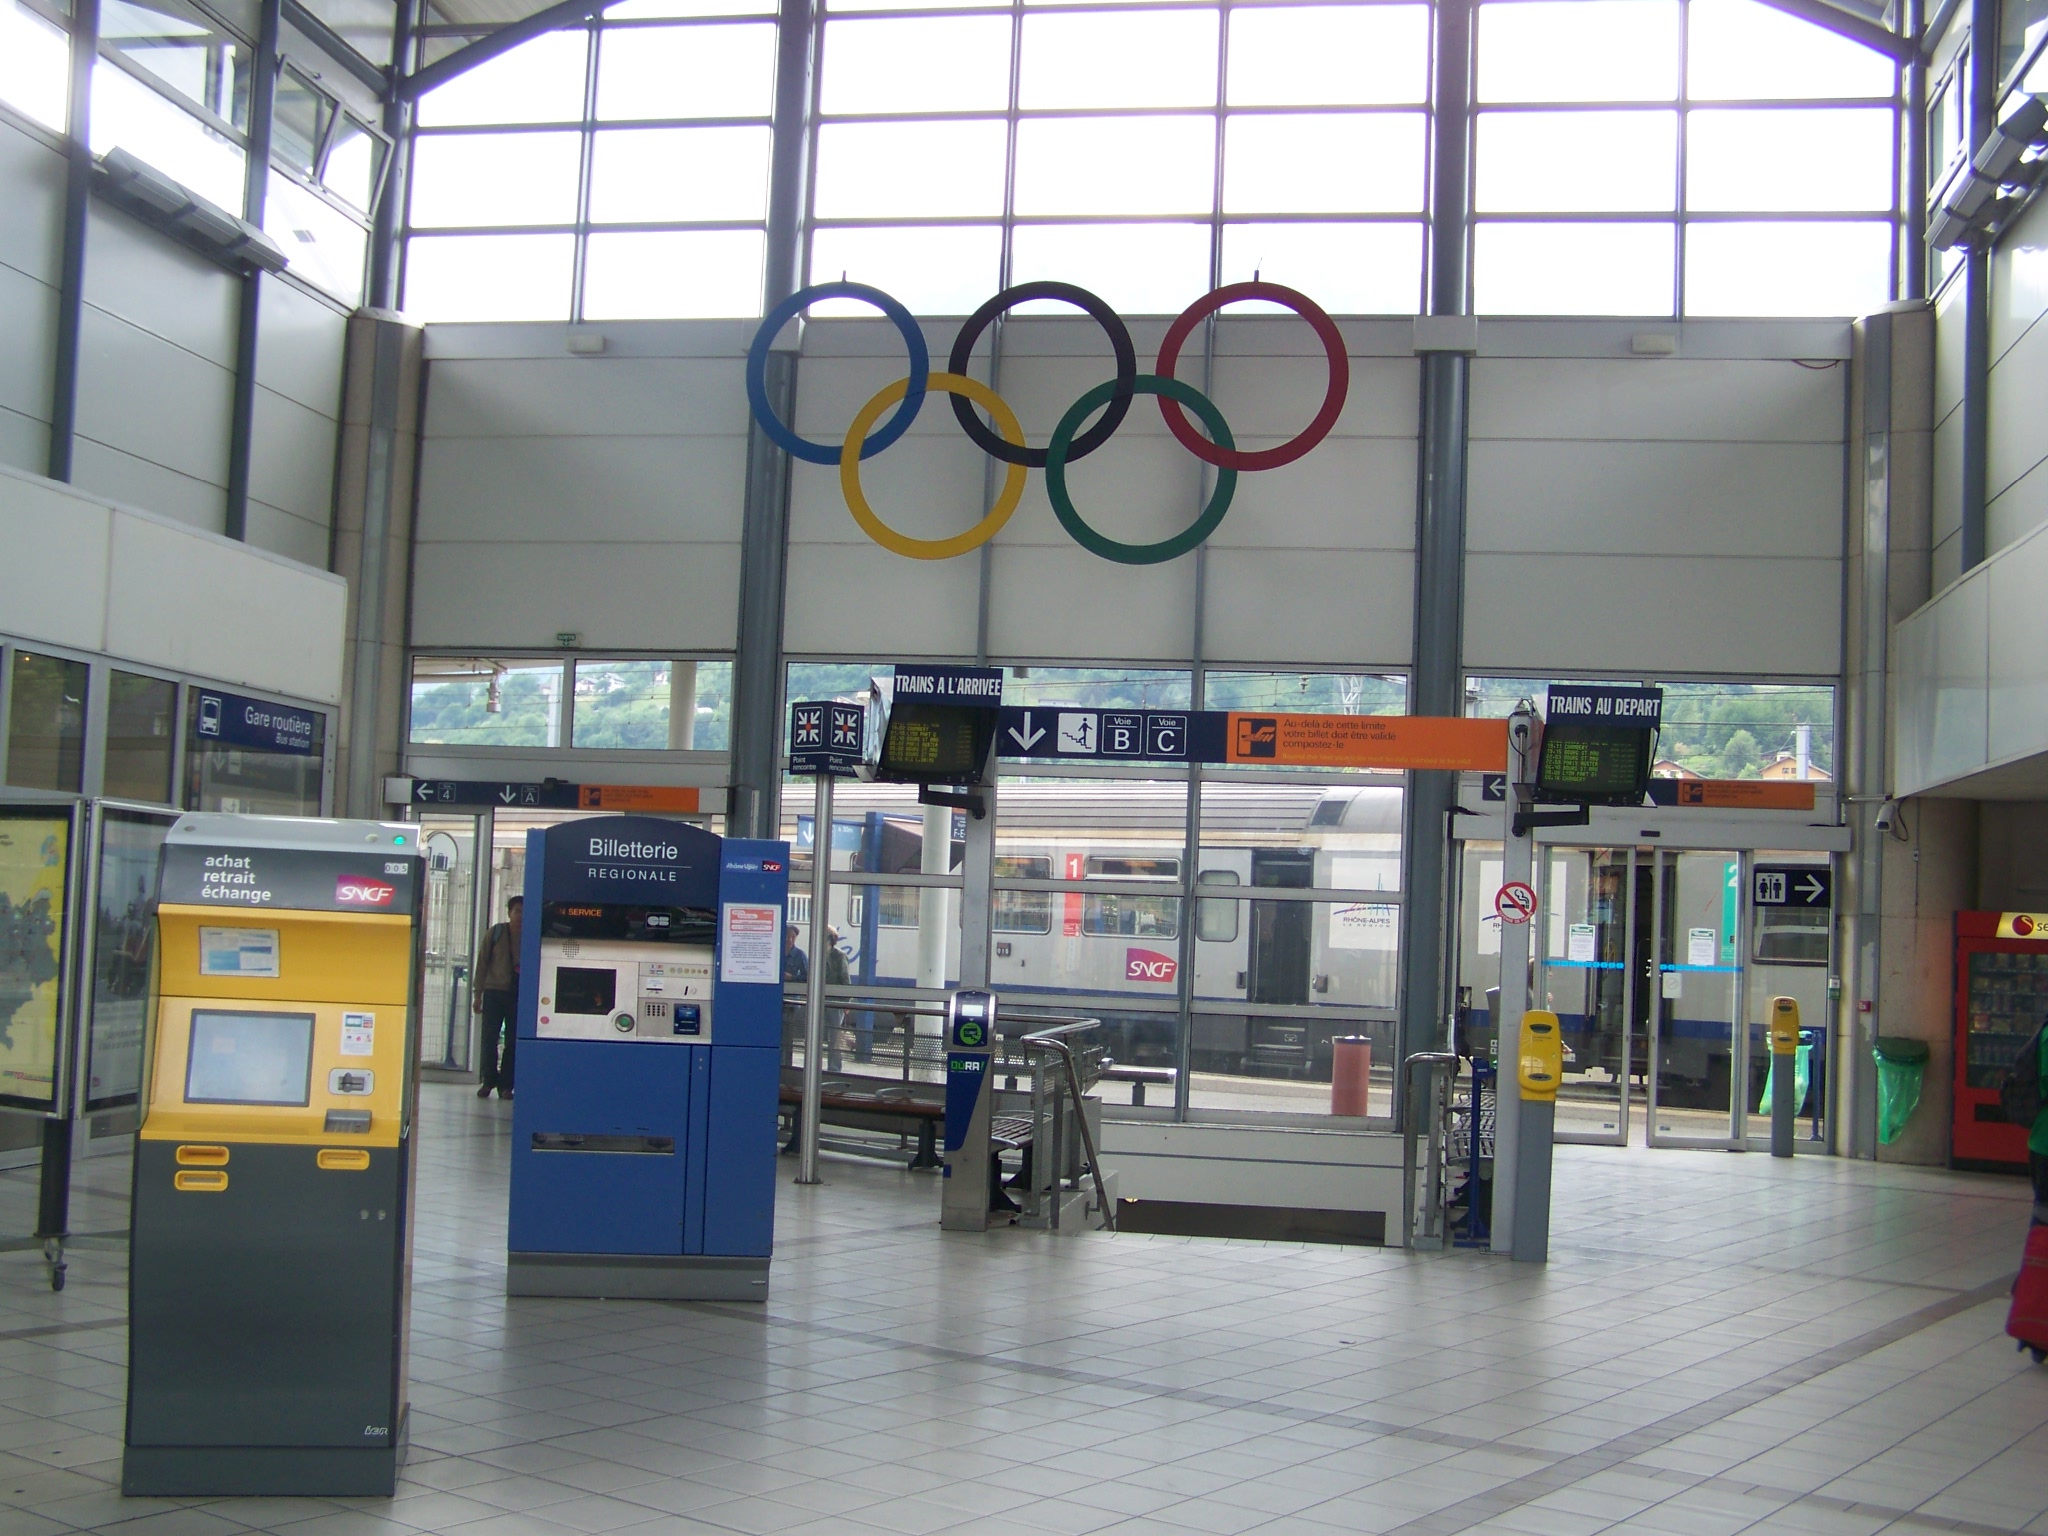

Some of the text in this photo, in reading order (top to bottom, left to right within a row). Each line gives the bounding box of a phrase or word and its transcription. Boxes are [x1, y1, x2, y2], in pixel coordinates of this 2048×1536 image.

[895, 675, 1002, 696] TRAINS A L'ARRIVEE
[1550, 696, 1660, 717] TRAINS AU DEPART
[245, 706, 311, 735] Gare routière
[1113, 717, 1132, 725] Voie
[1158, 718, 1176, 727] Voie
[1284, 719, 1386, 730] Au-delà de cette limite
[275, 732, 310, 749] Bus station
[1114, 729, 1130, 750] B
[1157, 730, 1175, 752] C
[1283, 729, 1397, 741] votre billet doit être validé
[1282, 740, 1345, 749] compostez-le
[829, 756, 843, 764] Point
[525, 792, 535, 803] A
[589, 838, 678, 860] Billetterie
[205, 854, 251, 869] achat
[385, 863, 408, 874] 005
[1070, 858, 1078, 878] 1
[203, 870, 256, 884] retrait
[588, 868, 677, 882] REGIONALE
[201, 885, 272, 903] échange
[338, 886, 393, 902] SNCF
[568, 908, 602, 917] SERVICE
[1128, 961, 1175, 978] SNCF
